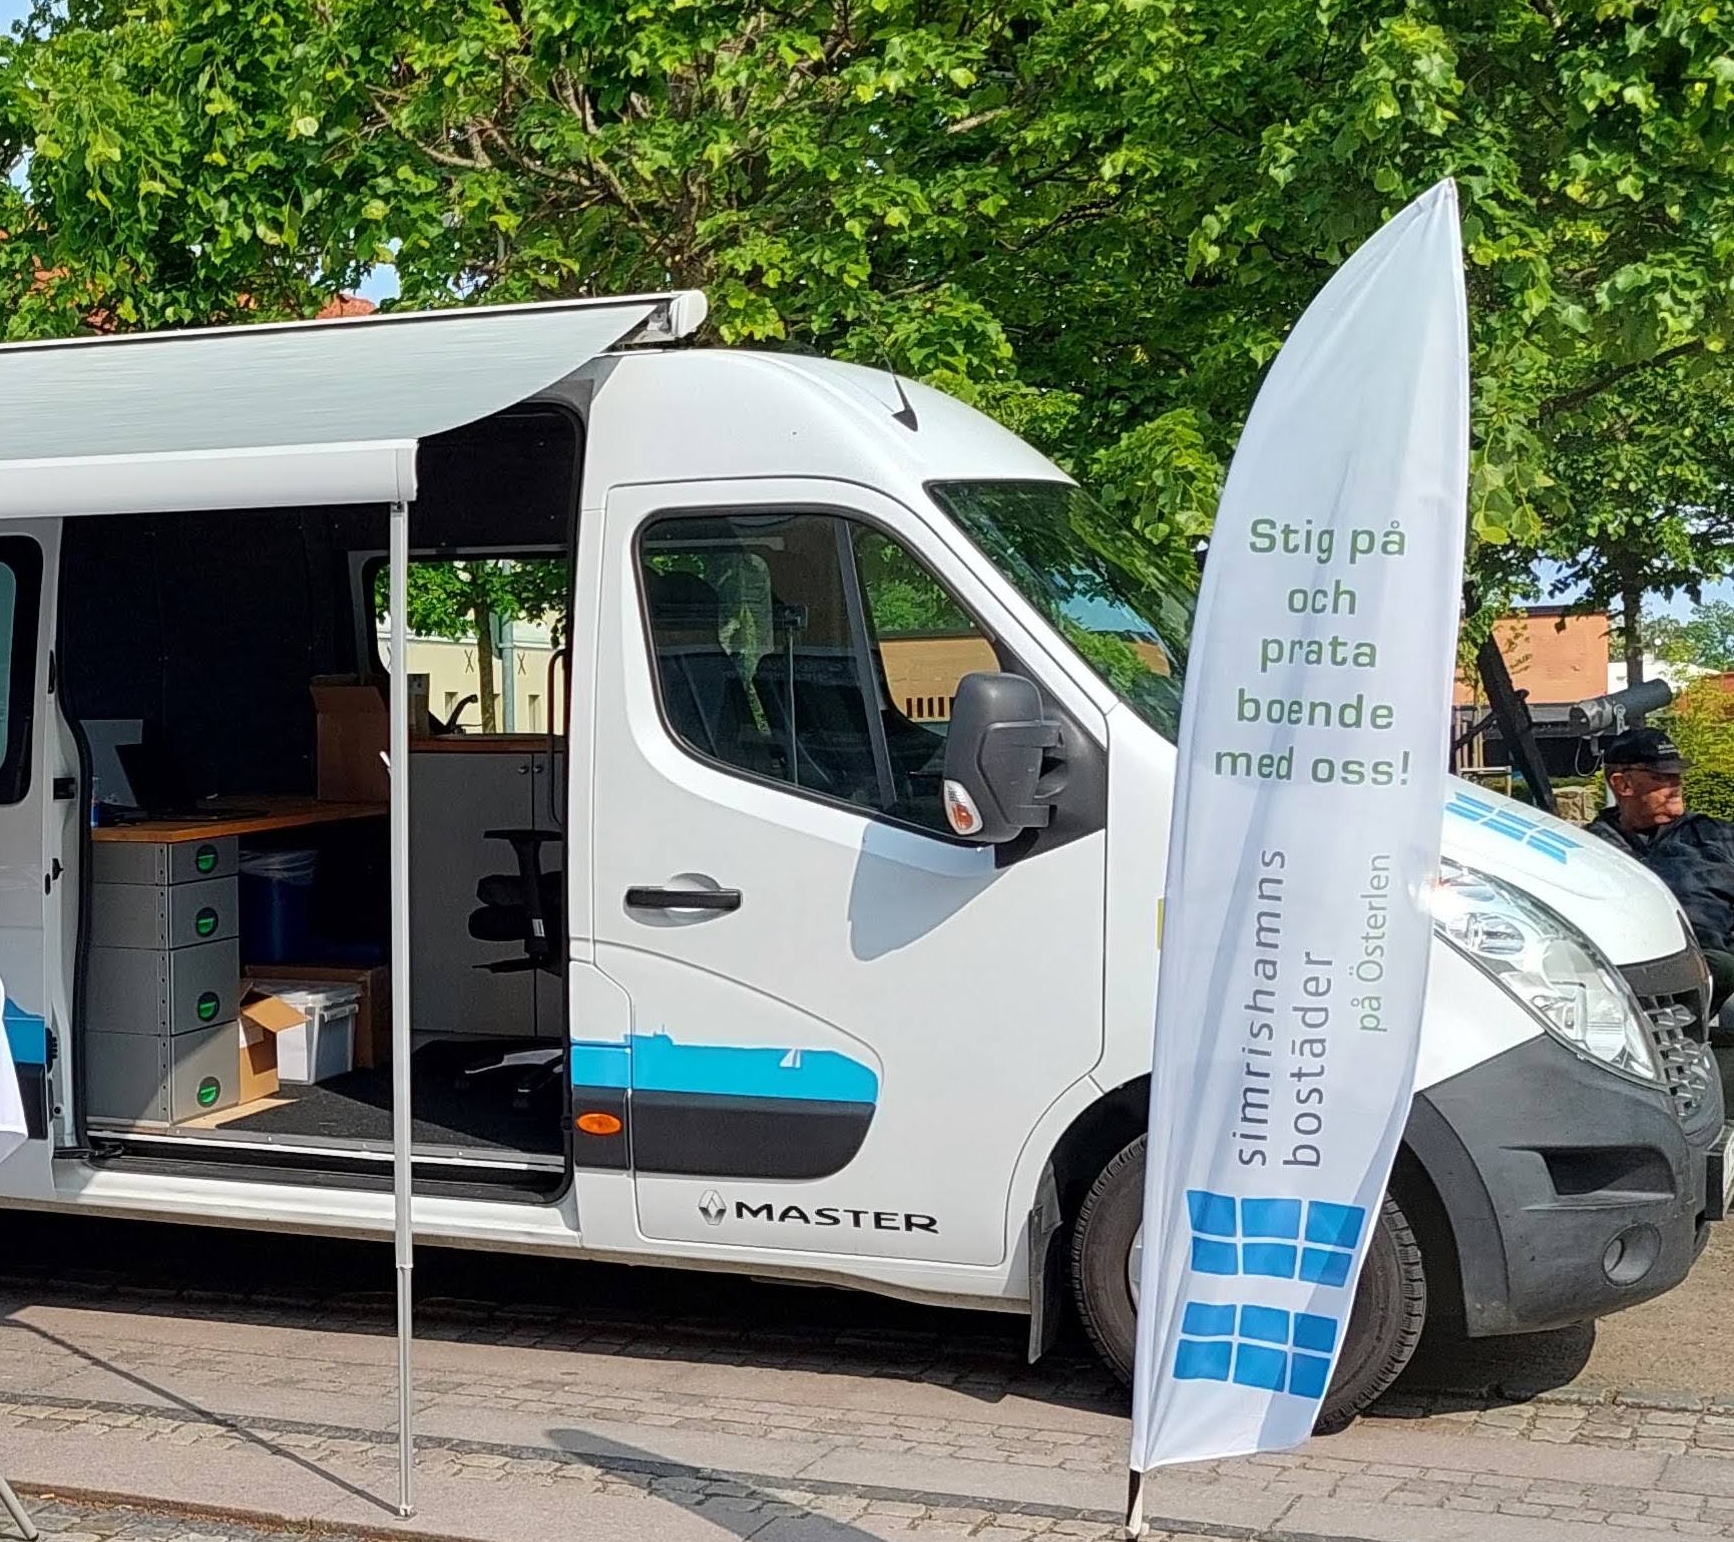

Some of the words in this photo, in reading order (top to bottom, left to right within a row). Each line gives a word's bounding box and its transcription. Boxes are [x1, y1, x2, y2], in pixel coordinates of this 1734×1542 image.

[1249, 518, 1335, 565] Stig
[1349, 520, 1406, 565] på
[1287, 578, 1357, 616] och
[1260, 635, 1378, 673] prata
[1237, 687, 1395, 730] boende
[1215, 745, 1295, 781] med
[1310, 750, 1411, 786] oss!
[1348, 853, 1391, 984] Österlen
[1231, 849, 1287, 1167] simrishamns
[1350, 994, 1388, 1033] på
[735, 1201, 940, 1234] MASTER
